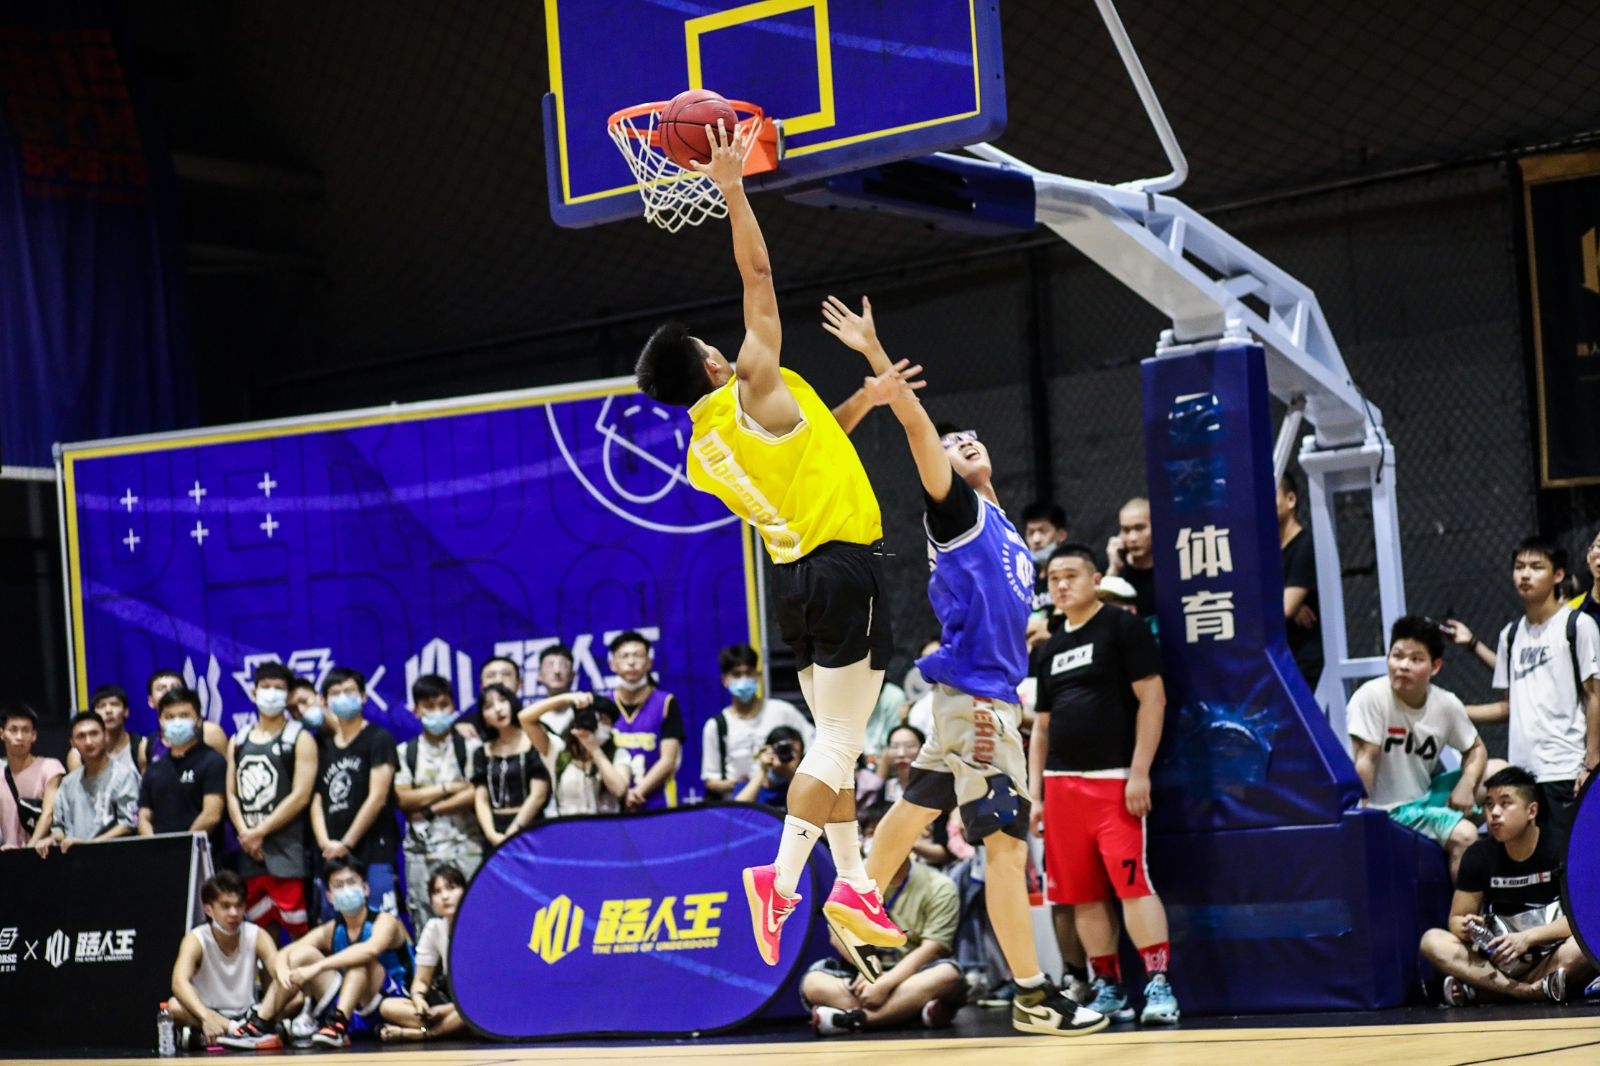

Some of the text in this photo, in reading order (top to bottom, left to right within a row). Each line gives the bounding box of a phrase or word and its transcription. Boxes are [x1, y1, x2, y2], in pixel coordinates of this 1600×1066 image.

[1175, 525, 1235, 643] 体育
[1122, 860, 1136, 886] 7
[592, 891, 728, 945] 路人王
[75, 928, 136, 957] 路人王
[592, 943, 611, 954] THE
